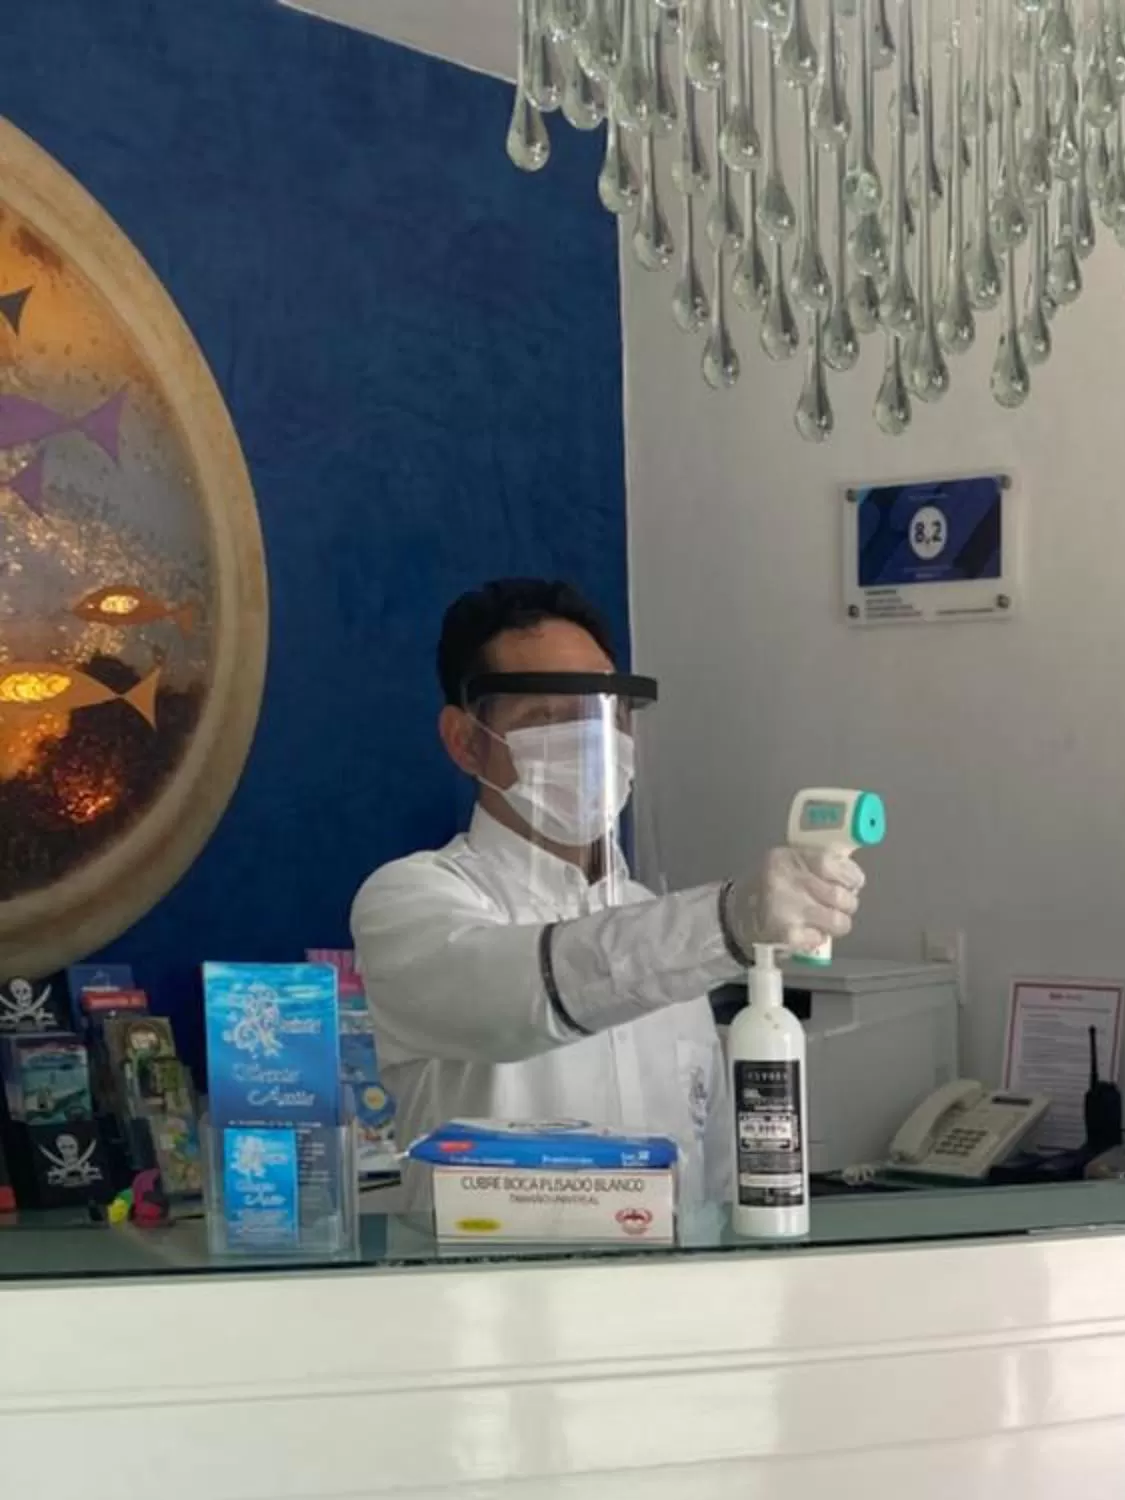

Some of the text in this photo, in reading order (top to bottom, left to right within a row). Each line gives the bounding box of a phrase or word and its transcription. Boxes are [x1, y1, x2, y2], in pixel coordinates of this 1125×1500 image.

[460, 1175, 500, 1191] CUBRE
[504, 1176, 538, 1192] BOCA
[595, 1177, 645, 1193] BLANCO
